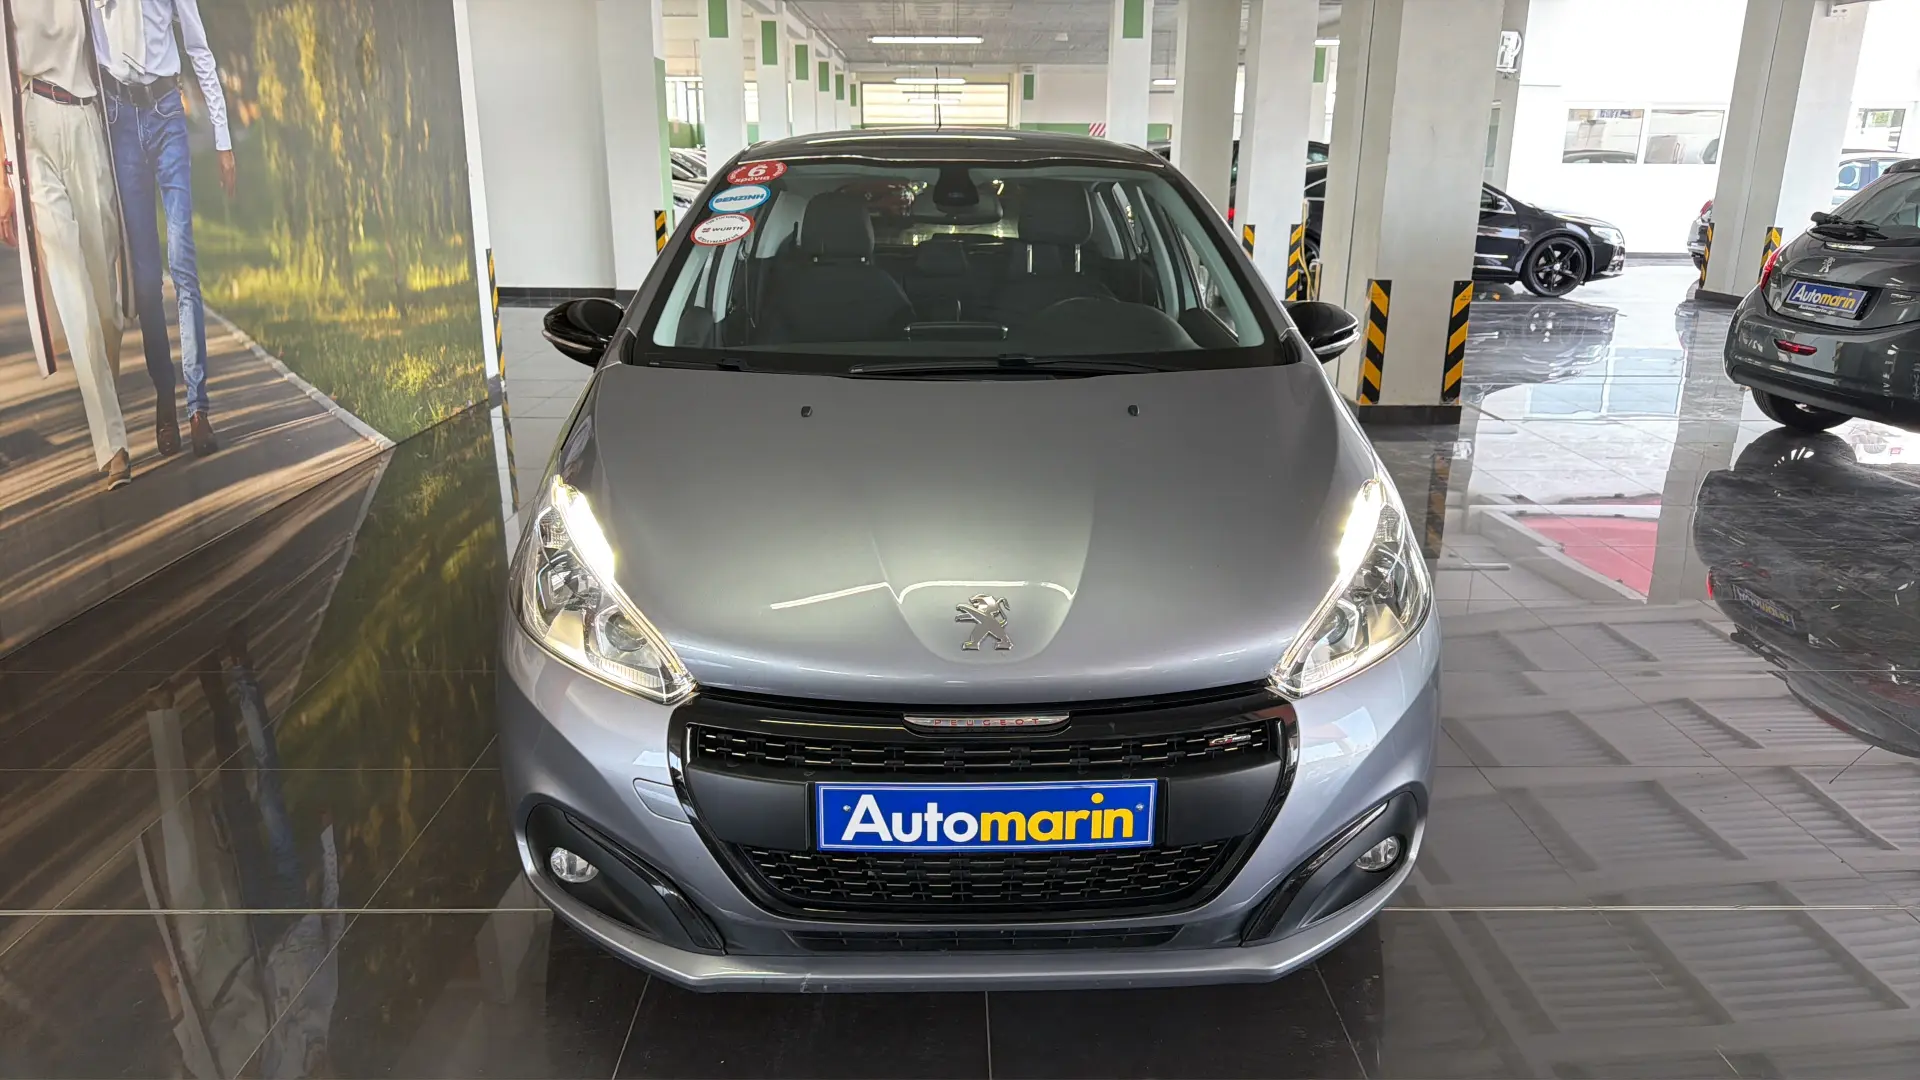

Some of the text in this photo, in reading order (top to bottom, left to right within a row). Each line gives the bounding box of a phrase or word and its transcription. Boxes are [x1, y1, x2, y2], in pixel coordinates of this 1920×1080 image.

[747, 164, 768, 177] 6
[1792, 285, 1857, 309] Automarin
[934, 718, 1039, 726] PEUGEOT
[841, 793, 1134, 843] Automarin
